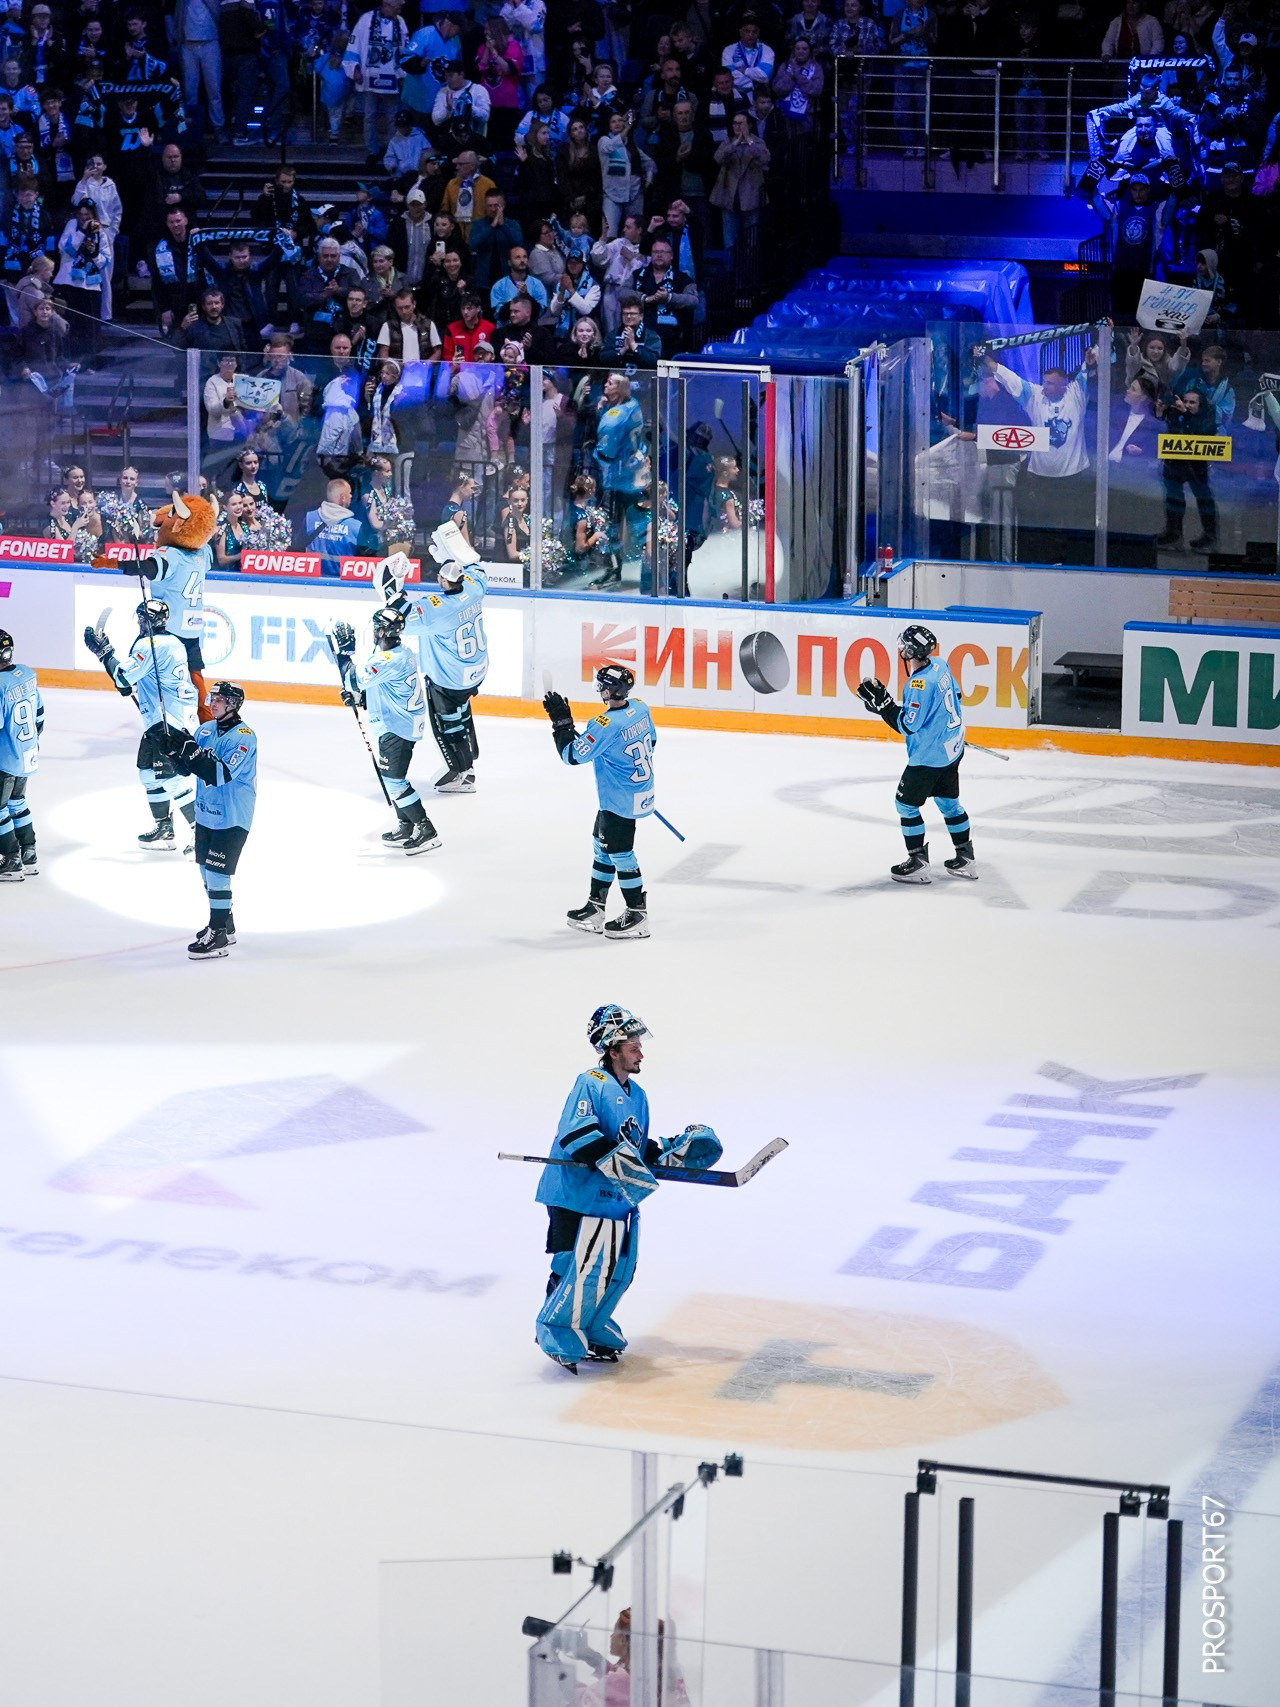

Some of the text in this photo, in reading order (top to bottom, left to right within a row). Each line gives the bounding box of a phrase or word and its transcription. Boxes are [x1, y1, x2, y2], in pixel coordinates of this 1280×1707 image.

[243, 554, 320, 572] FONBET
[341, 560, 419, 579] FONT
[906, 711, 916, 724] 9
[573, 738, 591, 756] 38
[836, 1060, 1208, 1291] БАНК
[549, 1284, 572, 1322] TRUE
